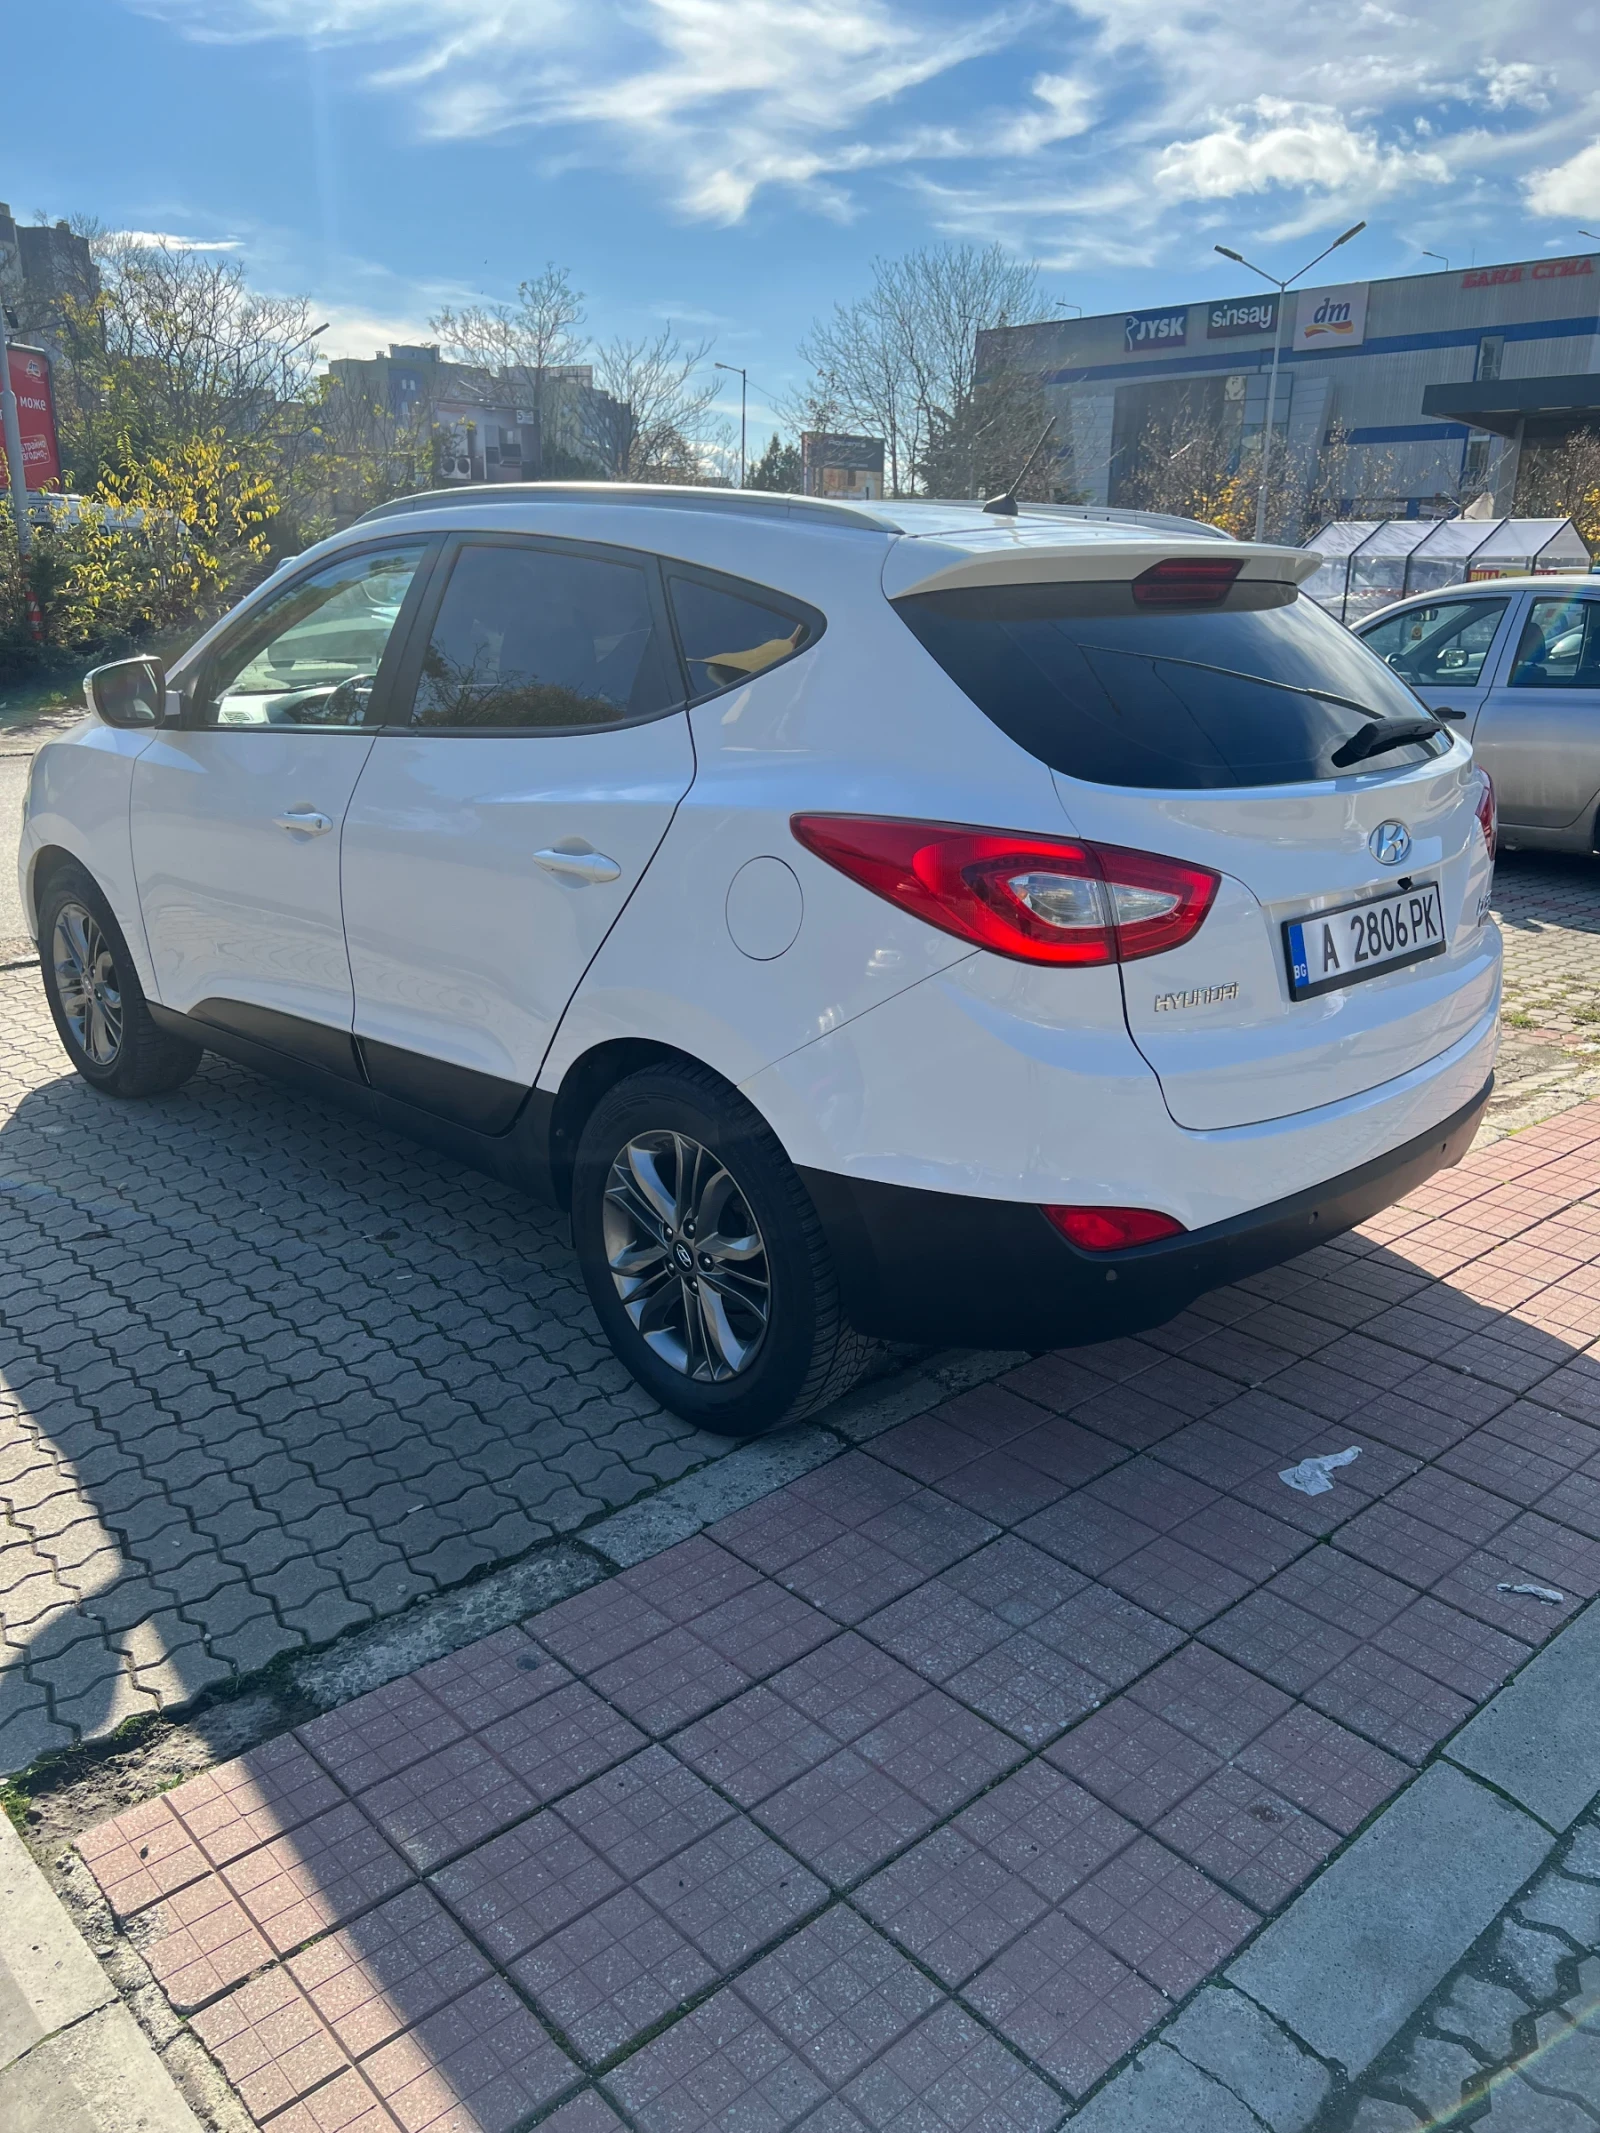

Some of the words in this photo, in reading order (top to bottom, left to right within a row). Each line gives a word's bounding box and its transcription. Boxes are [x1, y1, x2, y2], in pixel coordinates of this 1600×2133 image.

[1461, 266, 1523, 289] БАНЯ
[1531, 258, 1594, 280] СТИЛ
[1211, 304, 1273, 329] sinsay
[1313, 297, 1350, 325] dm
[1136, 315, 1185, 341] JYSK
[1323, 923, 1340, 973] A
[1350, 903, 1409, 963] 2806
[1409, 894, 1438, 944] PK
[1294, 963, 1307, 979] BG
[1154, 981, 1240, 1012] HYUNDAI
